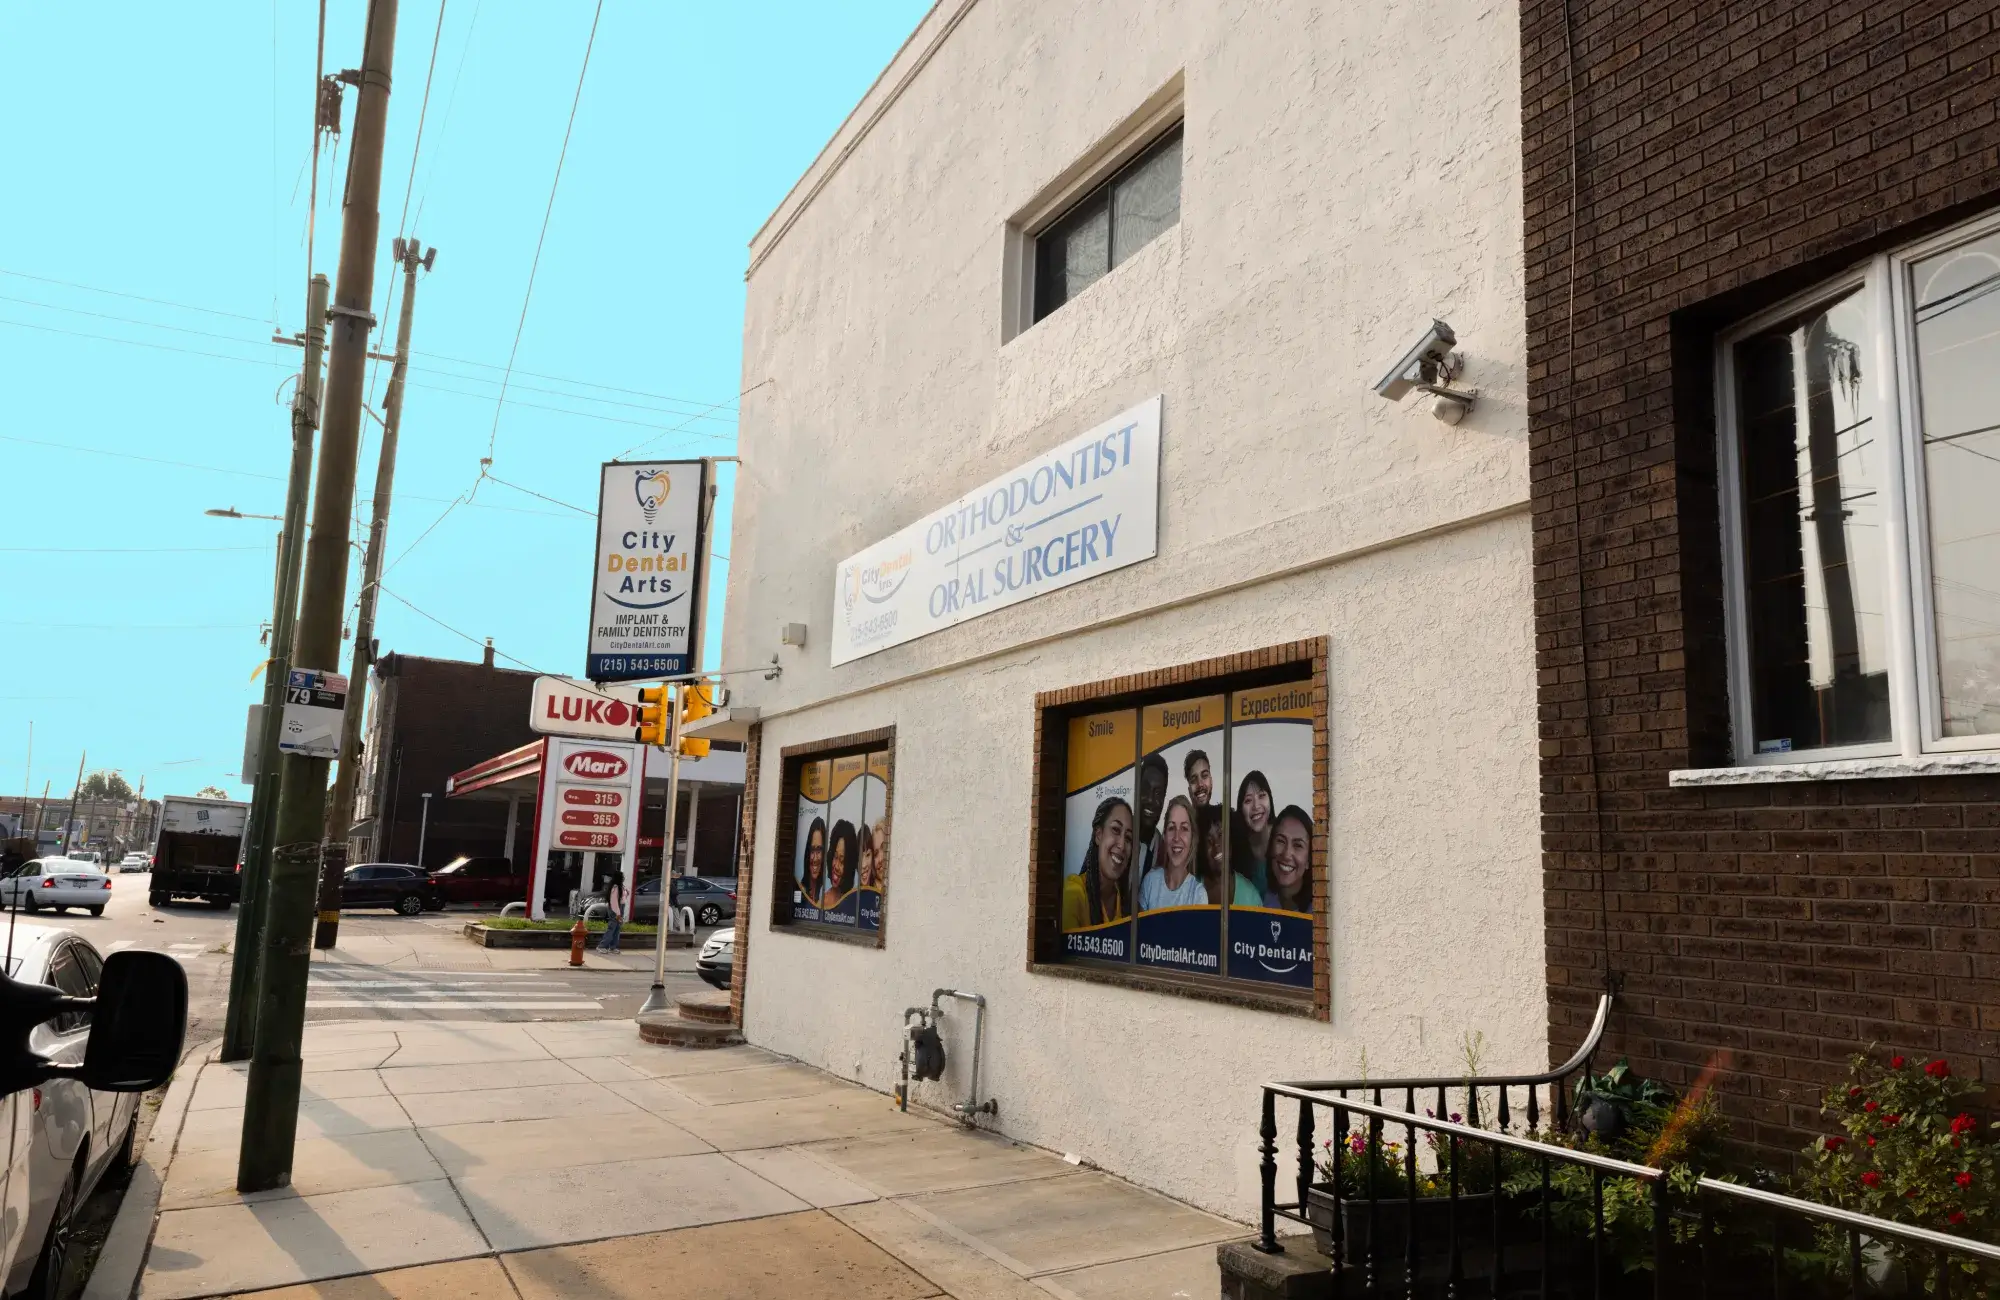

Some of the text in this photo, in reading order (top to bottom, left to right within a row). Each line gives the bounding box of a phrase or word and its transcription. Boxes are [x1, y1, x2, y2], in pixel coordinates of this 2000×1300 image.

[926, 421, 1139, 555] ORTHODONTIST
[622, 530, 676, 553] City
[1004, 523, 1025, 548] &
[607, 552, 688, 573] Dental
[929, 513, 1122, 619] ORAL SURGERY
[619, 575, 672, 593] Arts
[615, 614, 669, 625] IMPLANT &
[597, 626, 686, 637] FAMILY DENTISTRY
[610, 641, 671, 650] CityDentalArt.com
[600, 658, 679, 673] (215) 543-6500
[290, 688, 311, 704] 79
[546, 695, 652, 728] LUKOI
[1162, 706, 1202, 731] Beyond
[1088, 720, 1114, 738] Smile
[570, 755, 623, 775] Mart
[594, 793, 613, 805] 315
[592, 813, 611, 825] 365
[590, 833, 610, 846] 385
[1067, 934, 1124, 957] 215.543.6500
[1140, 943, 1217, 968] CityDentalArt.com
[1234, 941, 1315, 962] City Dental Ar
